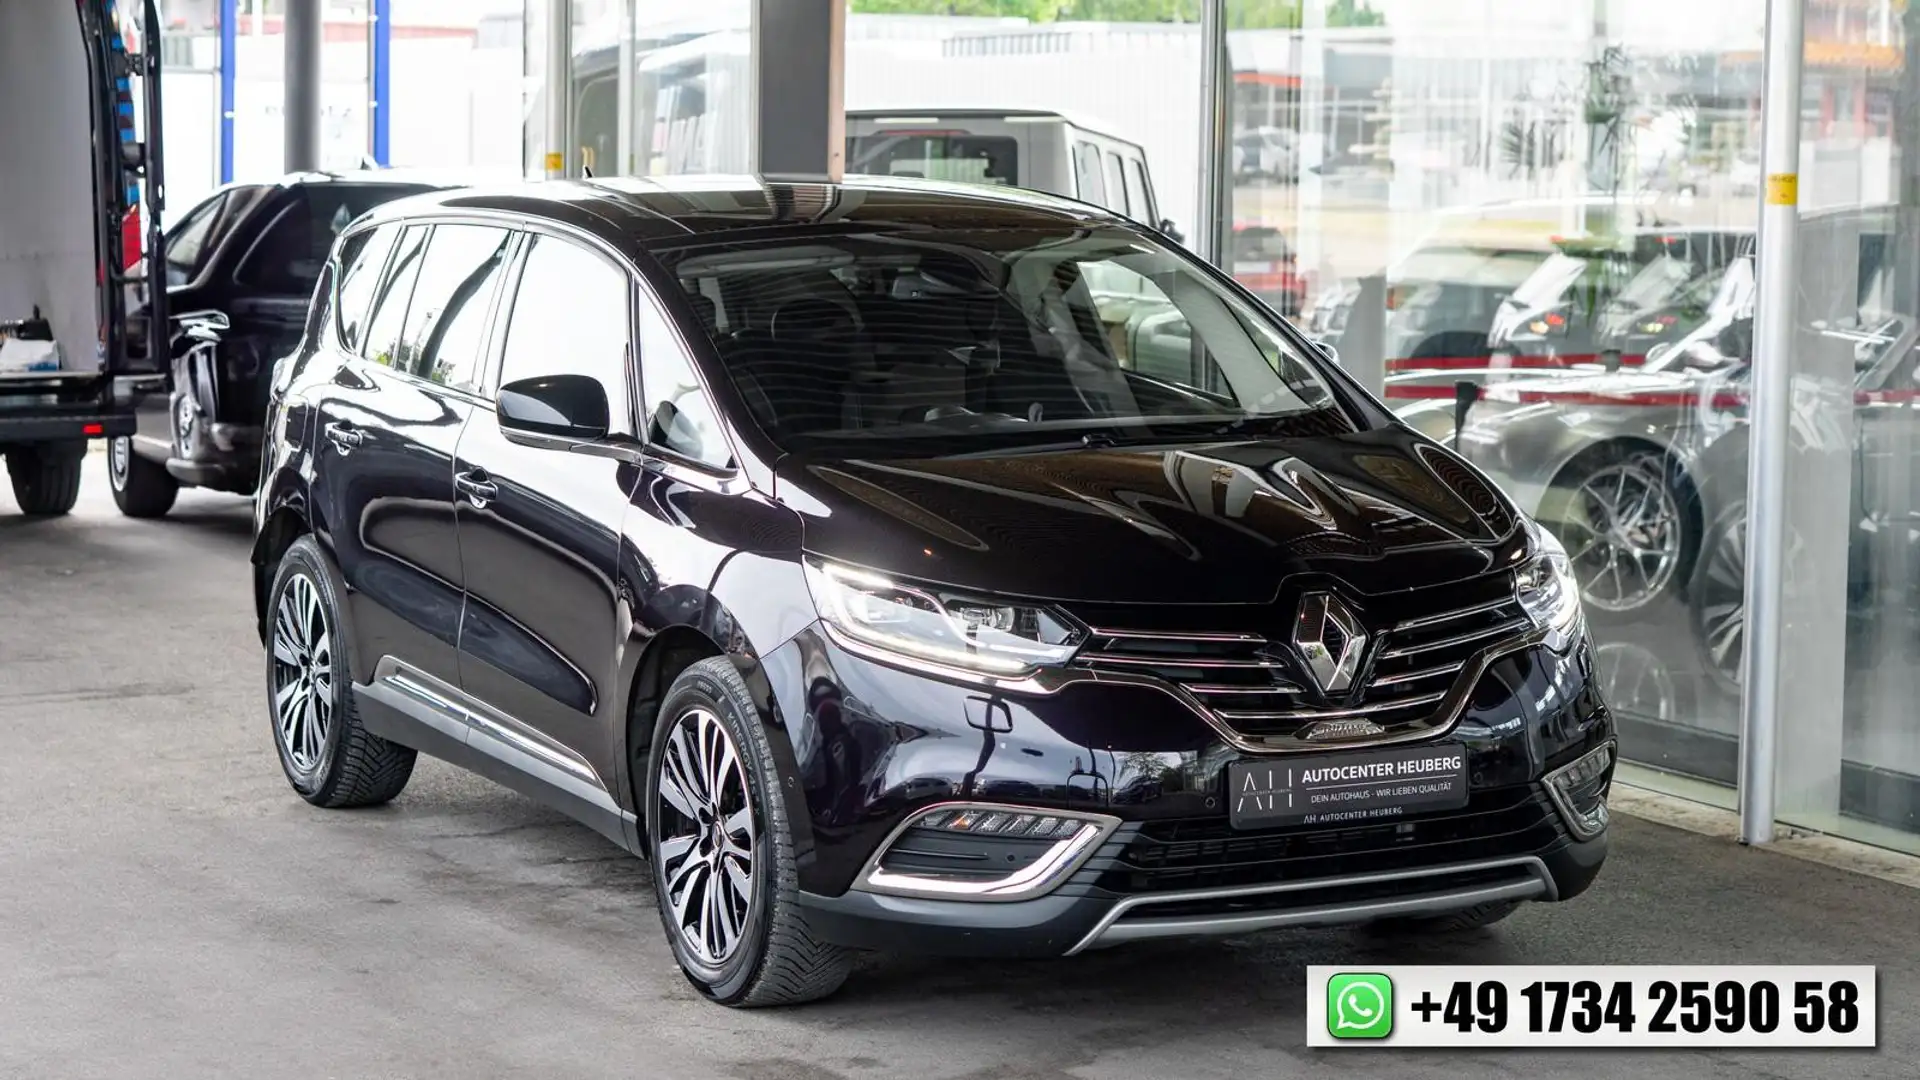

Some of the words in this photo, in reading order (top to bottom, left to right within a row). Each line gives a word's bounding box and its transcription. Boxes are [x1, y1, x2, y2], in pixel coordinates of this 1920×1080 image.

[1302, 763, 1394, 783] AUTOCENTER
[1397, 756, 1461, 775] HEUBERG
[1311, 794, 1329, 803] DEIN
[1330, 790, 1370, 801] AUTOHAUS
[1376, 788, 1391, 797] WIR
[1392, 785, 1417, 796] LIEBEN
[1419, 781, 1451, 794] QUALITÄT
[1320, 810, 1367, 822] AUTOCENTER
[1370, 806, 1403, 817] HEUBERG
